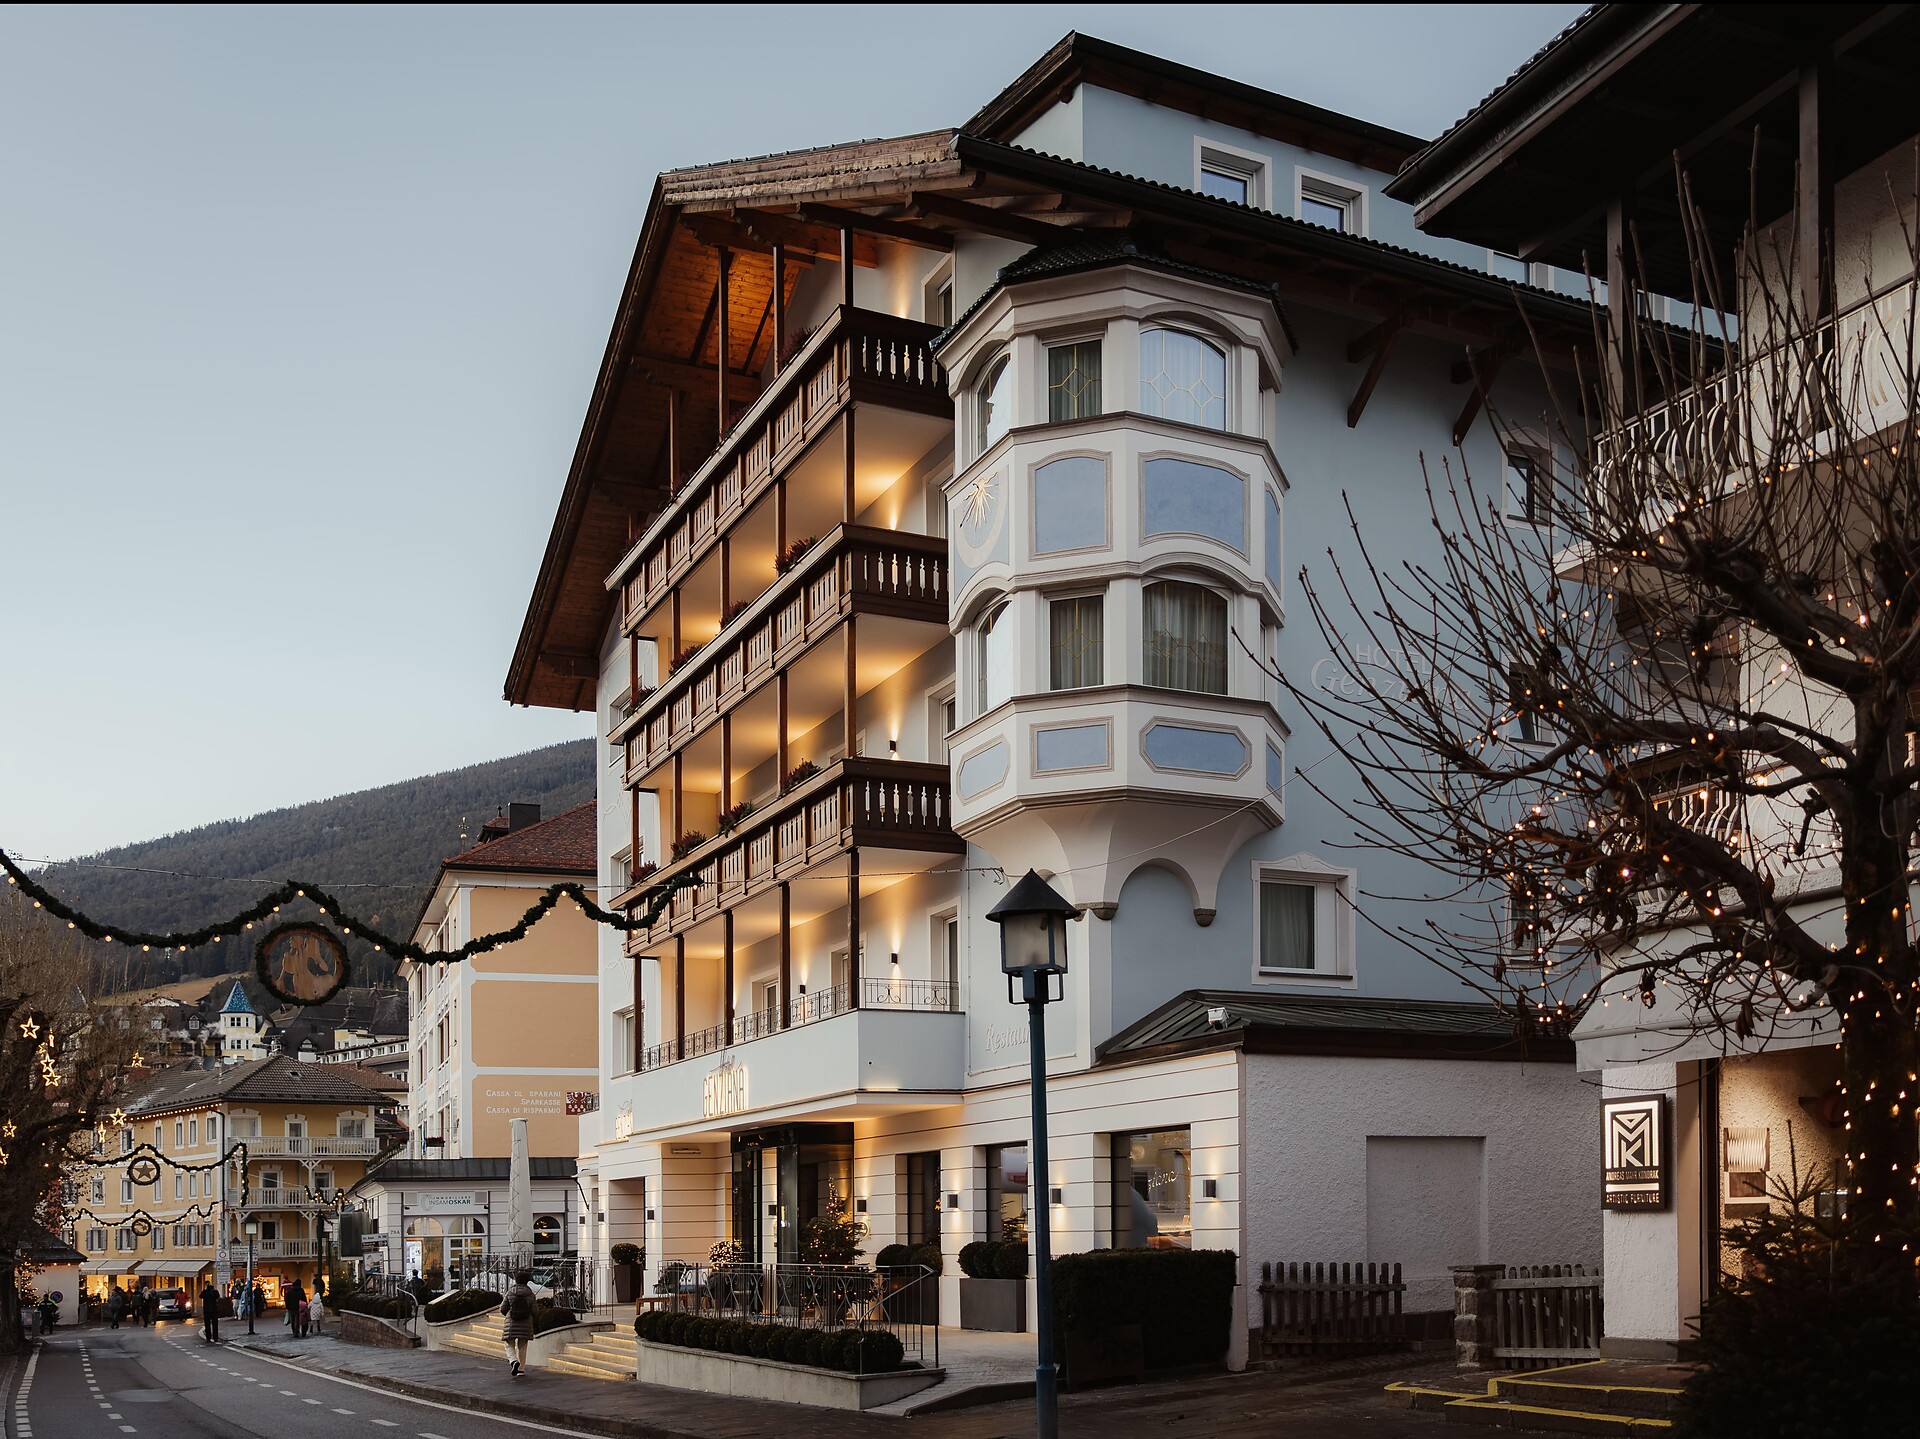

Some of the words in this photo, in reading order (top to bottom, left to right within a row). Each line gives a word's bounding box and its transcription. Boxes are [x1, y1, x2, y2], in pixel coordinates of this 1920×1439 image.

[1310, 658, 1471, 712] Genzina
[1355, 643, 1432, 676] HOTEL
[703, 1067, 745, 1118] GENZIANA
